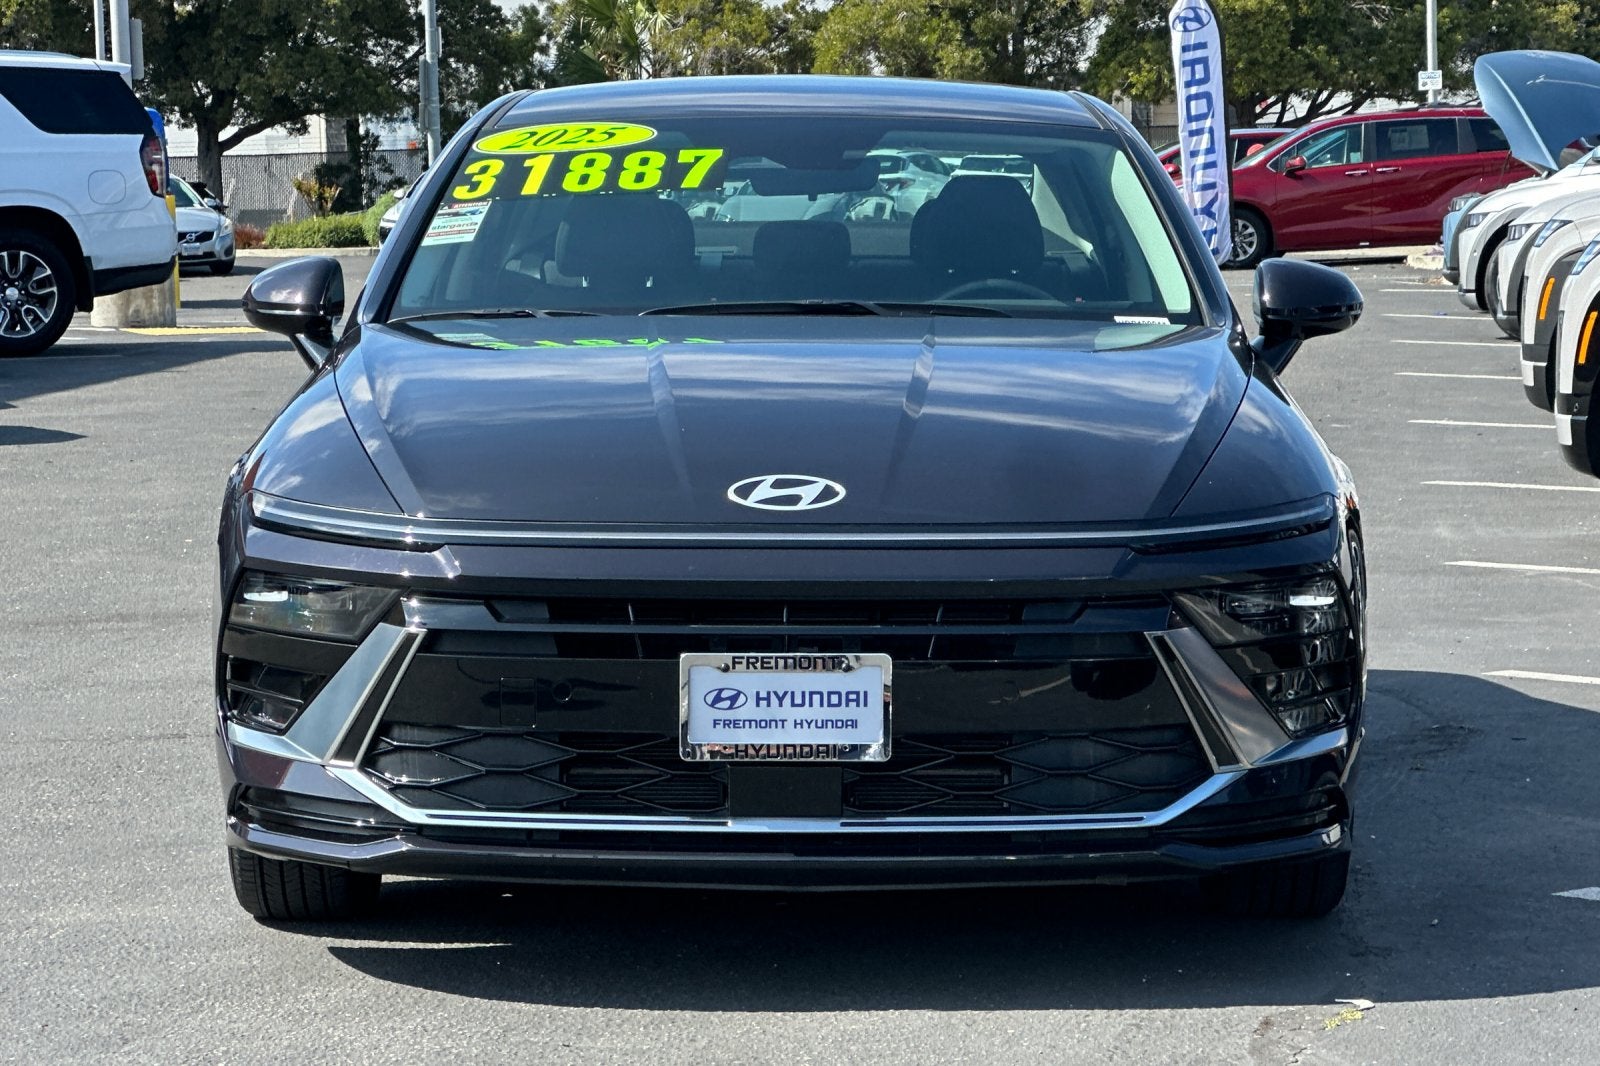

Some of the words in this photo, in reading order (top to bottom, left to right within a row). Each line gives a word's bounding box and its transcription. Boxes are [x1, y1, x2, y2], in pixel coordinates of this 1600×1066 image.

[500, 126, 628, 150] 2025
[452, 148, 724, 200] 31887
[731, 655, 840, 670] FREMONT
[755, 690, 868, 708] HYUNDAI
[712, 718, 788, 729] FREMONT
[793, 718, 858, 729] HYUNDAI
[734, 743, 838, 759] HYUNDAI
